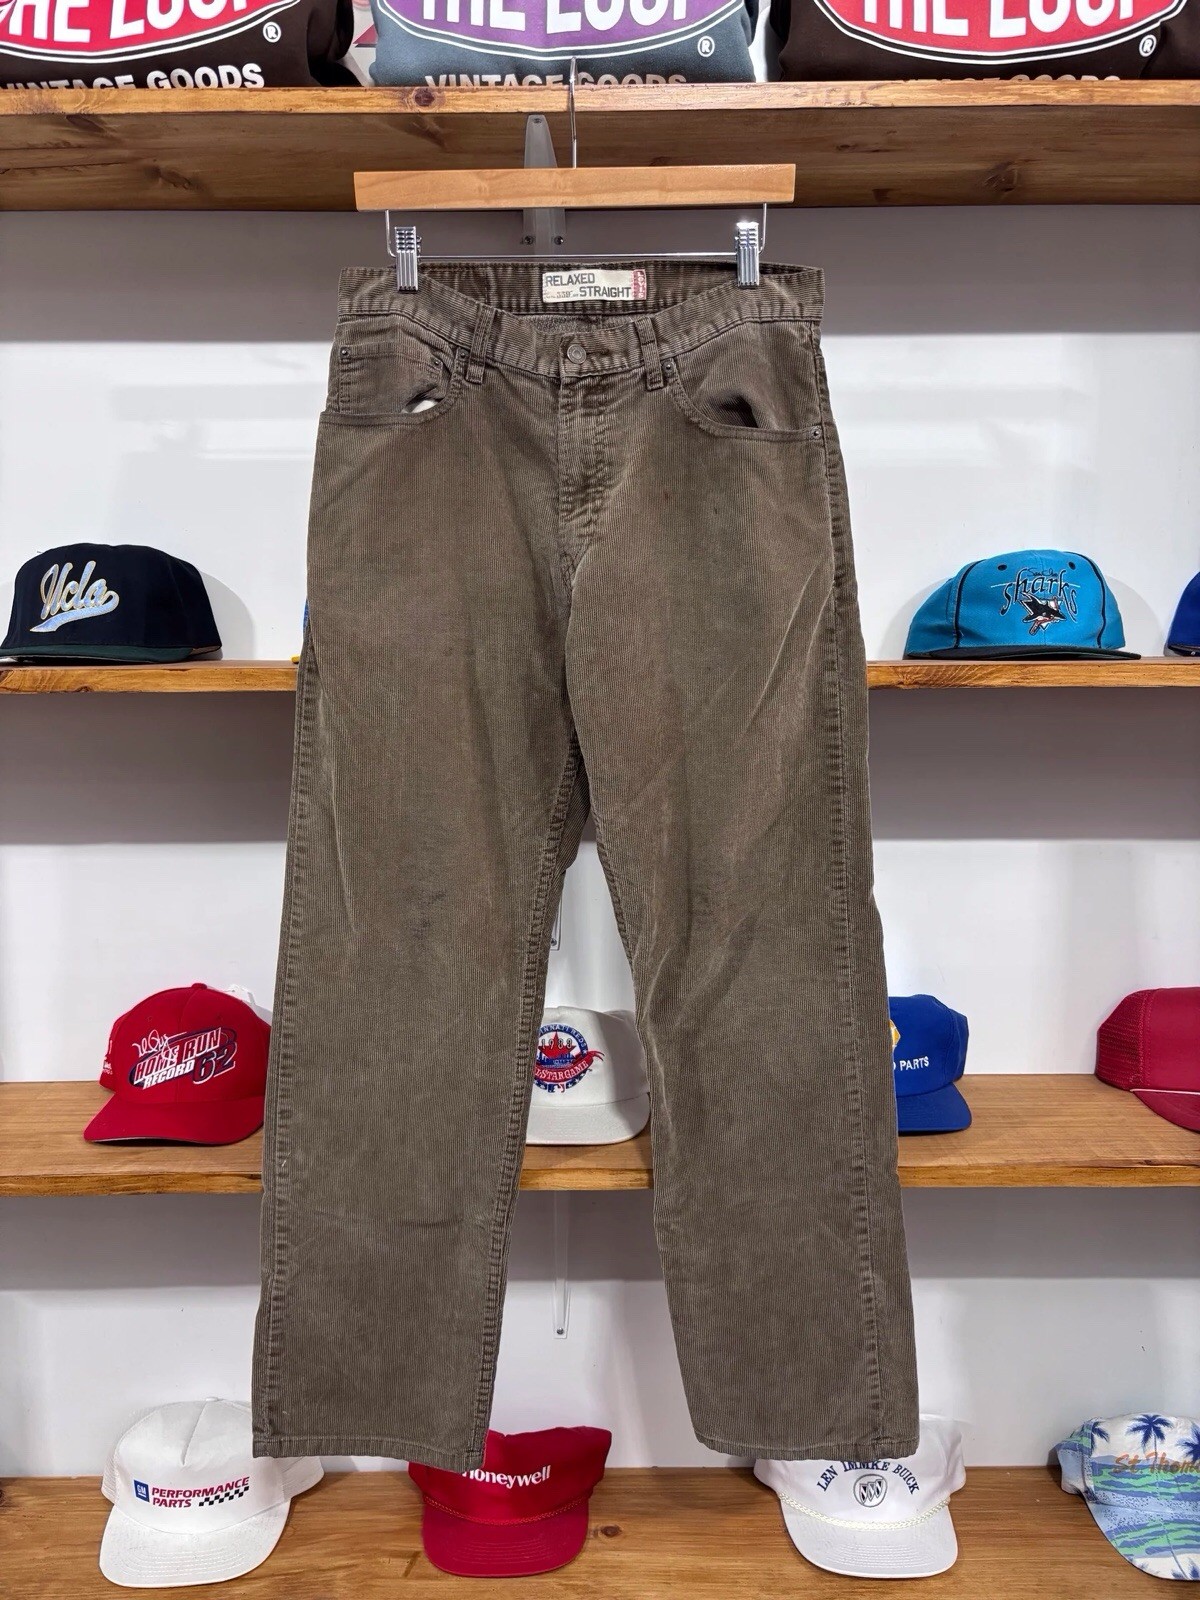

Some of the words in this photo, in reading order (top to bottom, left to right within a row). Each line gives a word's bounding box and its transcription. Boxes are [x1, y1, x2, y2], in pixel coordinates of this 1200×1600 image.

[146, 63, 265, 89] GOODS
[545, 273, 596, 287] RELAXED
[579, 286, 632, 298] STRAIGHT
[182, 1027, 222, 1062] RUN
[142, 1060, 196, 1090] RECORD
[899, 1055, 930, 1072] PARTS
[136, 1484, 147, 1496] GM
[151, 1476, 250, 1499] PERFORMANCE
[817, 1465, 838, 1491] LEN
[892, 1464, 920, 1494] BUICK
[152, 1497, 192, 1508] PARTS
